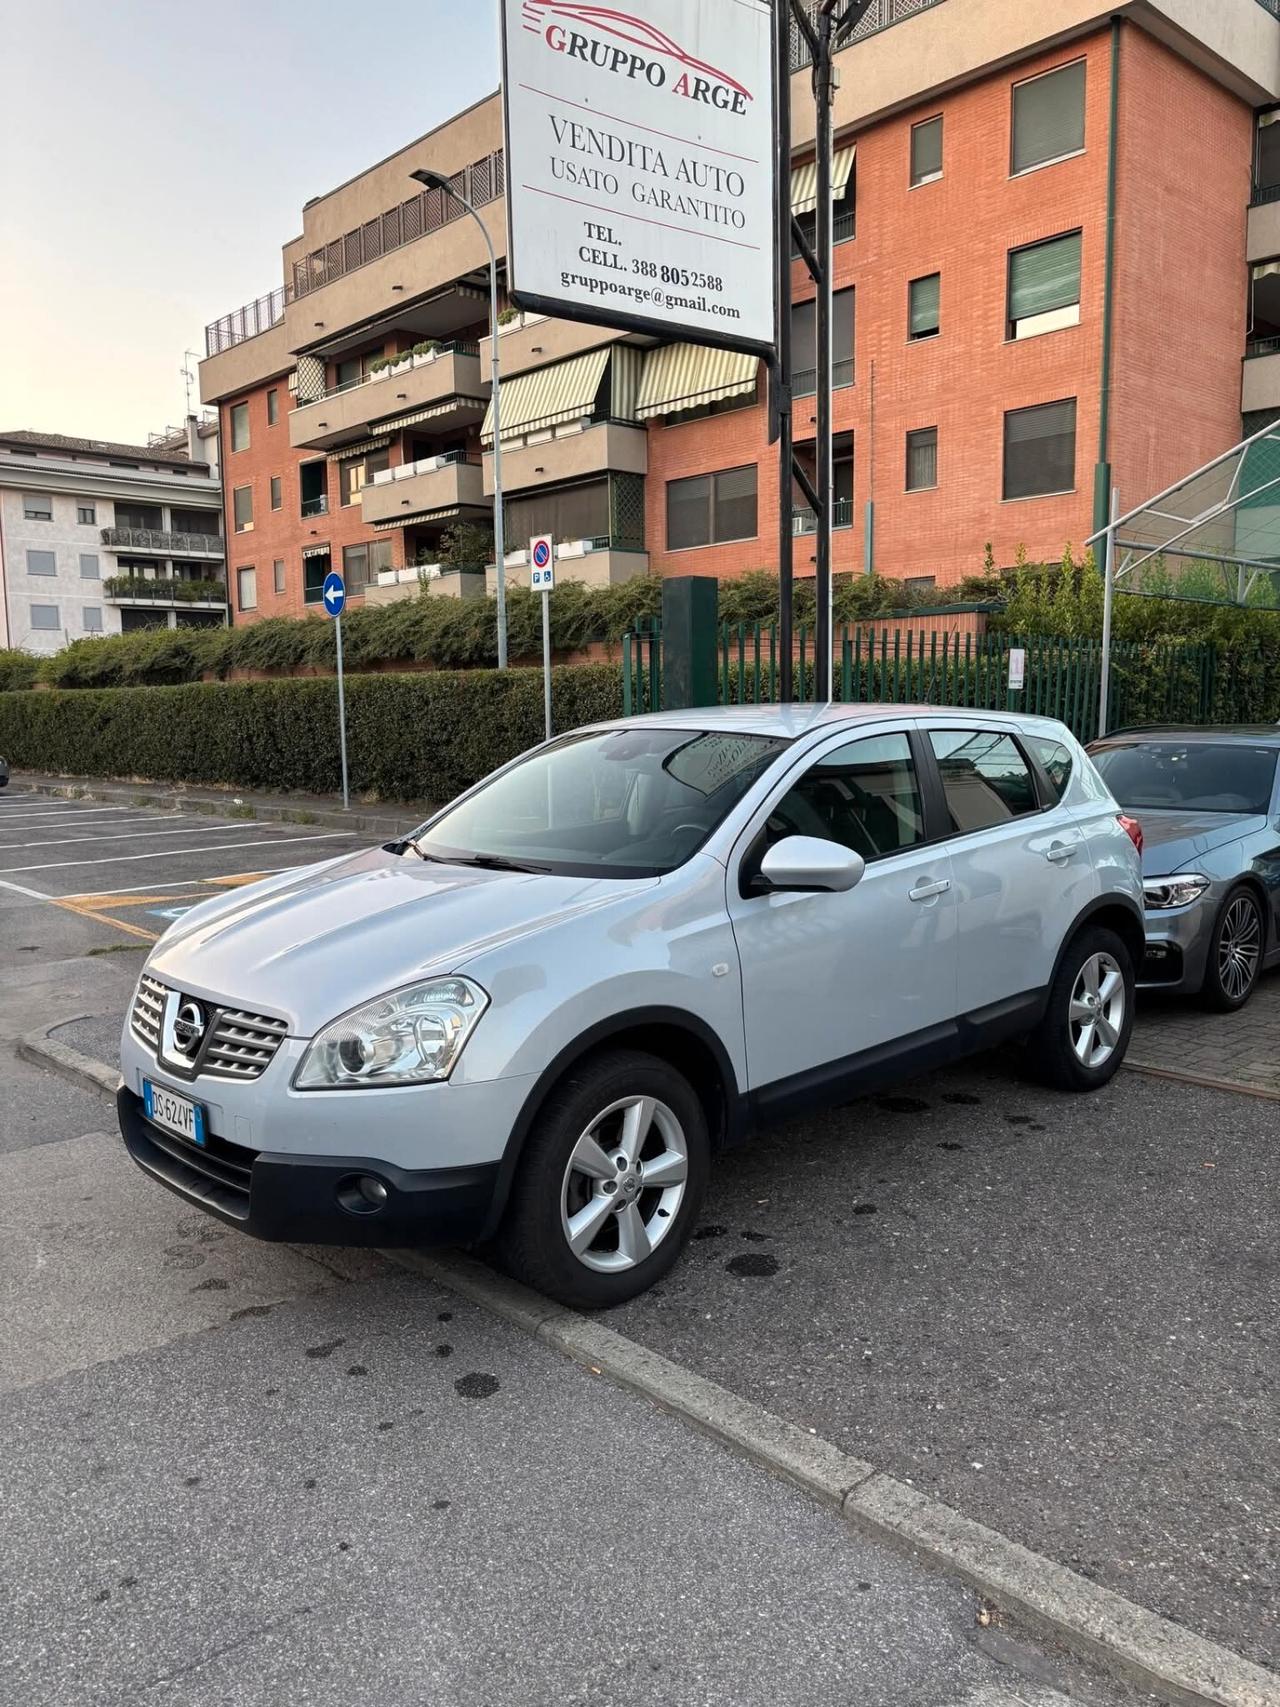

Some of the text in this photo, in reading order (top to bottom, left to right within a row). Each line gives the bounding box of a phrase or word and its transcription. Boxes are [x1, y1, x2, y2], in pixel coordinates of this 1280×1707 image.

[546, 25, 747, 115] GRUPPO ARGE
[548, 114, 744, 197] VENDITA AUTO
[550, 156, 745, 229] USATO GARANTITO
[579, 246, 627, 271] CELL.
[632, 259, 657, 278] 388
[584, 221, 622, 246] TEL.
[560, 271, 740, 319] gruppoarge@gmail.com
